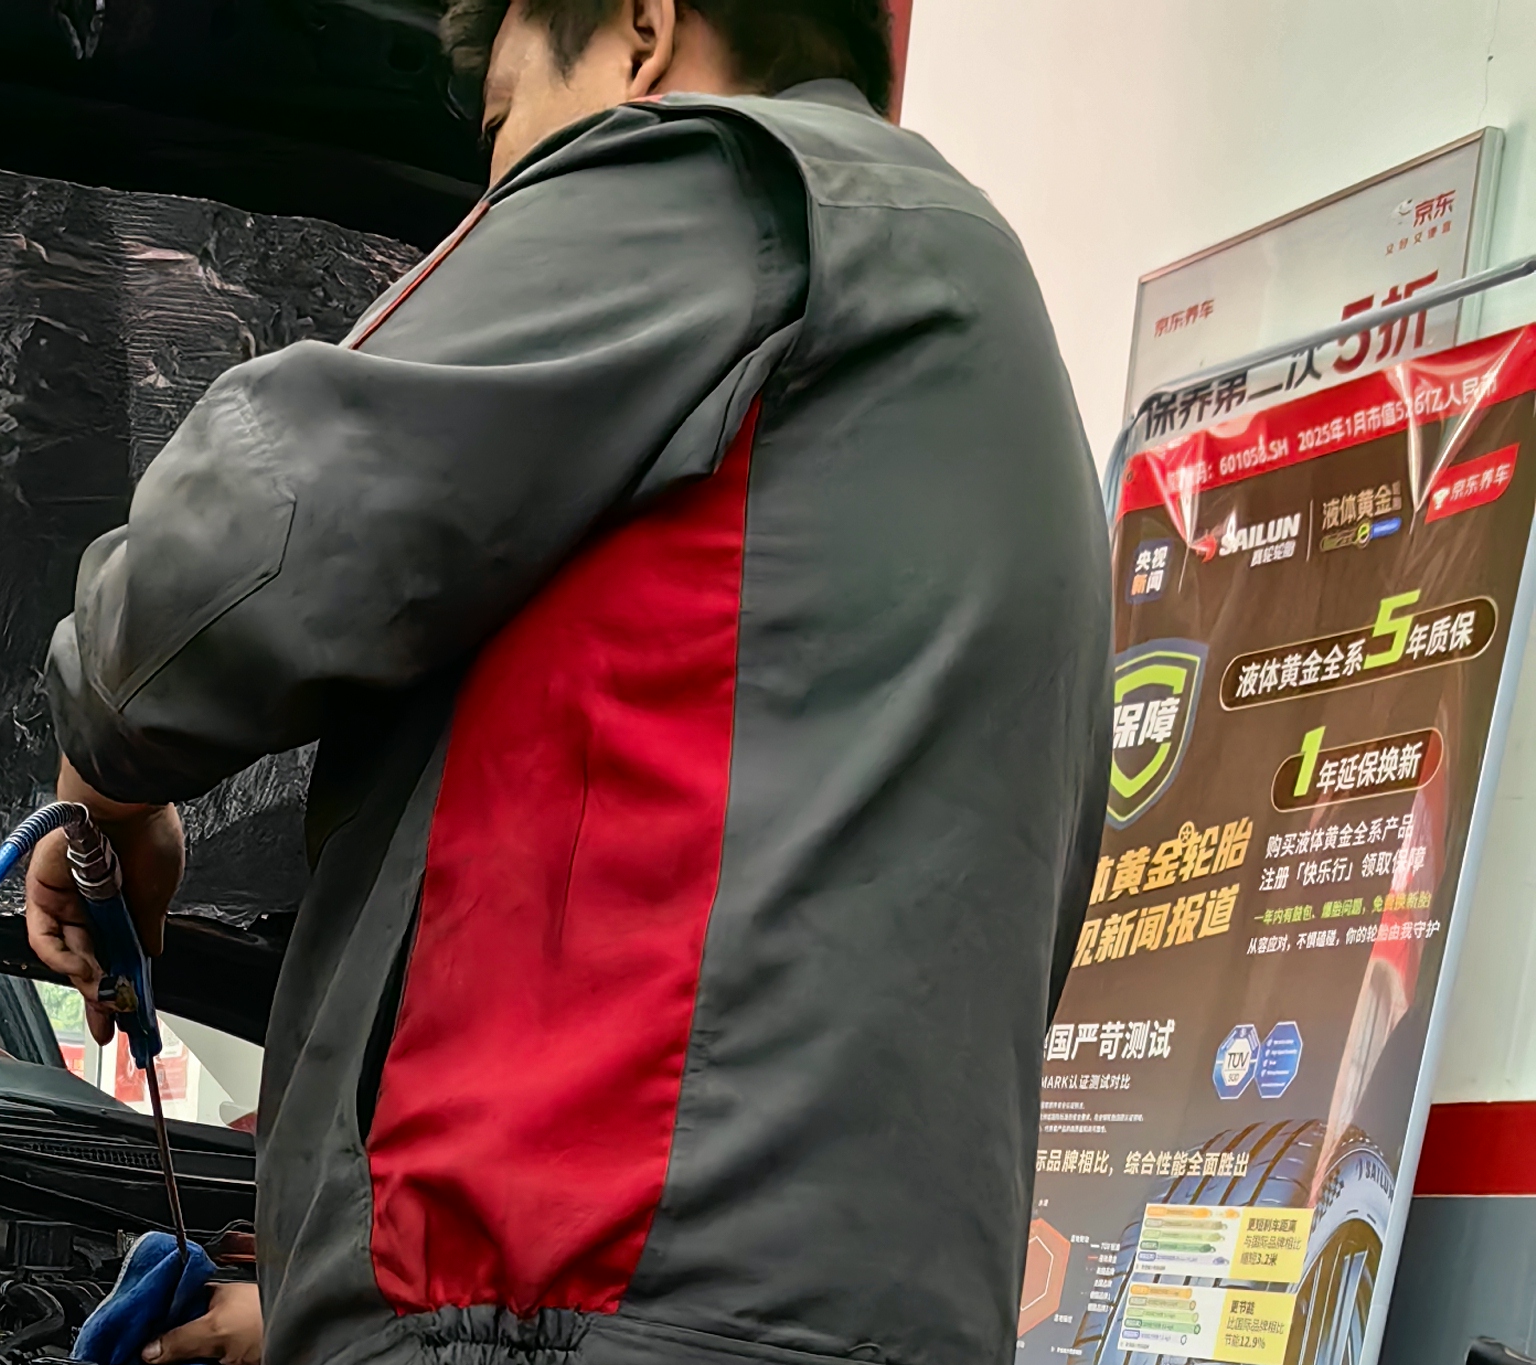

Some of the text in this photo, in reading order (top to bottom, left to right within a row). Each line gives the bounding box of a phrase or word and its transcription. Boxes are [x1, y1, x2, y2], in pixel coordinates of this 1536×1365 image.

[1413, 189, 1456, 228] 京东
[1153, 299, 1215, 338] 京东养车
[1450, 463, 1511, 501] 京东养车
[1322, 484, 1393, 531] 液体黄金
[1219, 513, 1302, 557] SAILUN
[1135, 546, 1169, 573] 央视
[1131, 570, 1164, 596] 新闻
[1265, 813, 1414, 860] 购买液体黄金全系产品
[1044, 1019, 1175, 1061] 国严苛测试
